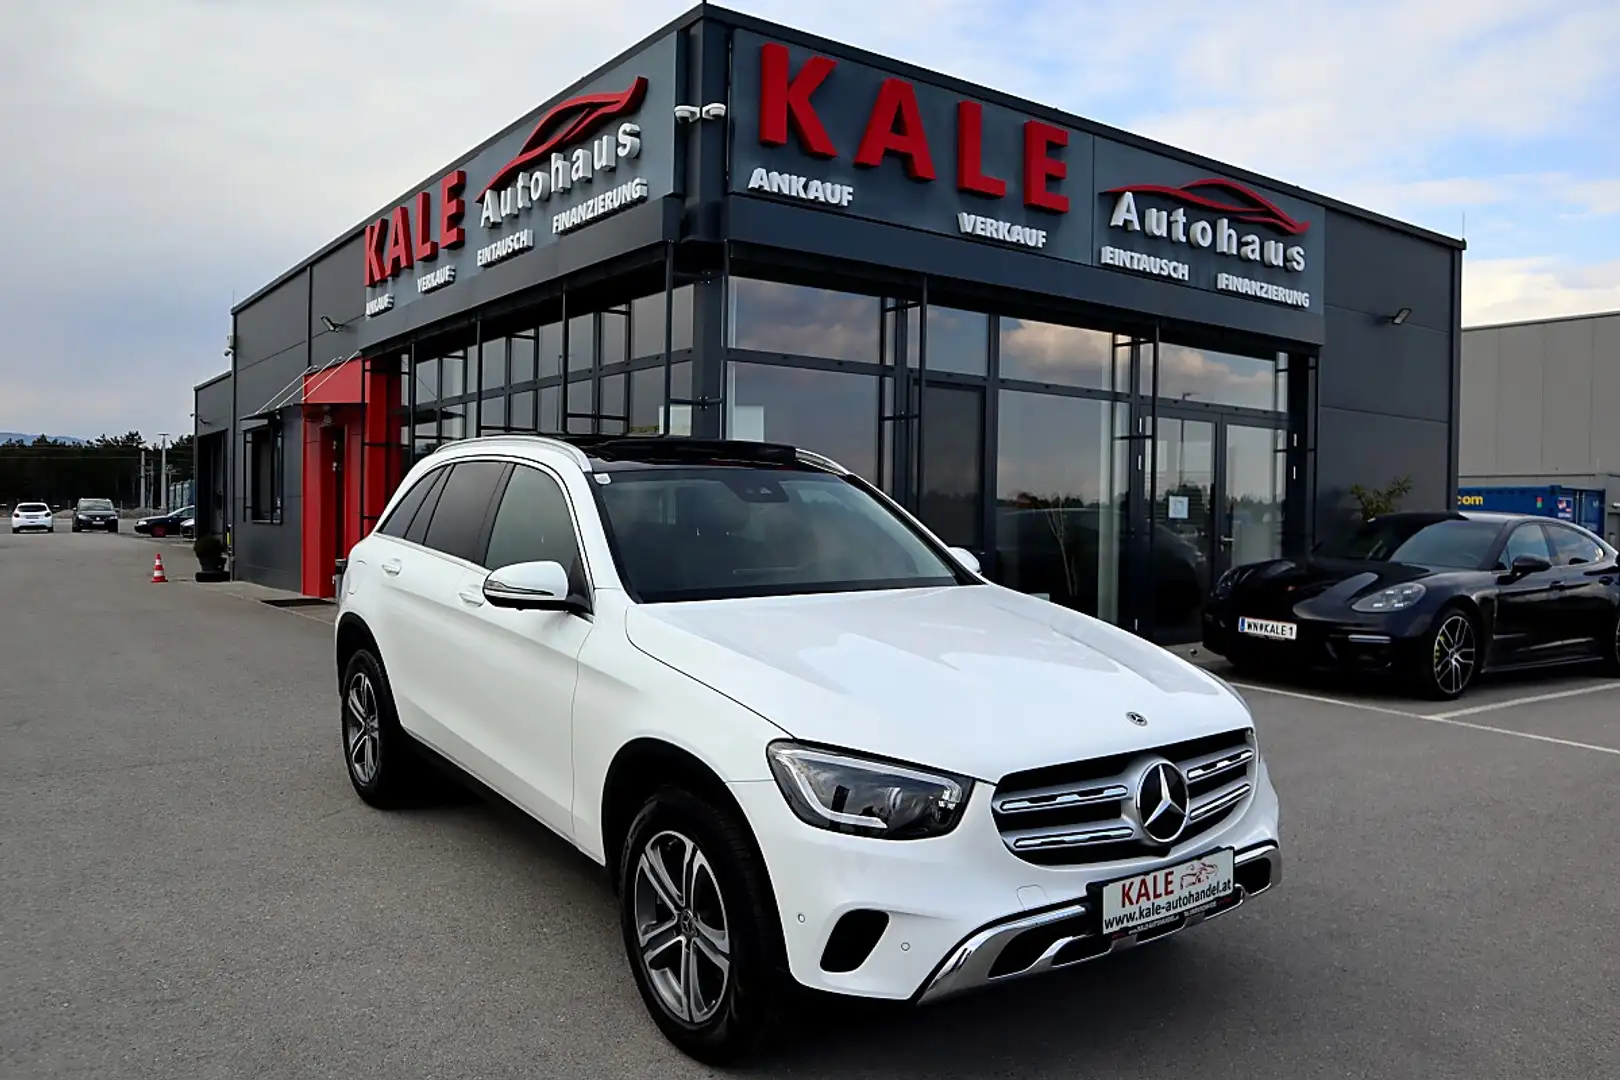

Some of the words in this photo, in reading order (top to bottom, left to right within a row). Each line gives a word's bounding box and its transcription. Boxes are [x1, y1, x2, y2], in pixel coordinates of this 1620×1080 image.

[480, 122, 641, 228] Autohaus
[759, 42, 1069, 213] KALE
[364, 170, 466, 287] KALE
[417, 265, 456, 292] VERKAUF
[477, 229, 534, 267] EINTAUSCH
[552, 178, 648, 234] FINANZIERUNG
[748, 167, 853, 207] ANKAUF
[957, 212, 1047, 248] VERKAUF
[1101, 246, 1189, 281] EINTAUSCH
[1216, 272, 1310, 308] FINANZIERUNG
[1110, 191, 1306, 272] Autohaus
[1105, 879, 1231, 930] www.kale-autohandel.at
[1121, 871, 1174, 908] KALE
